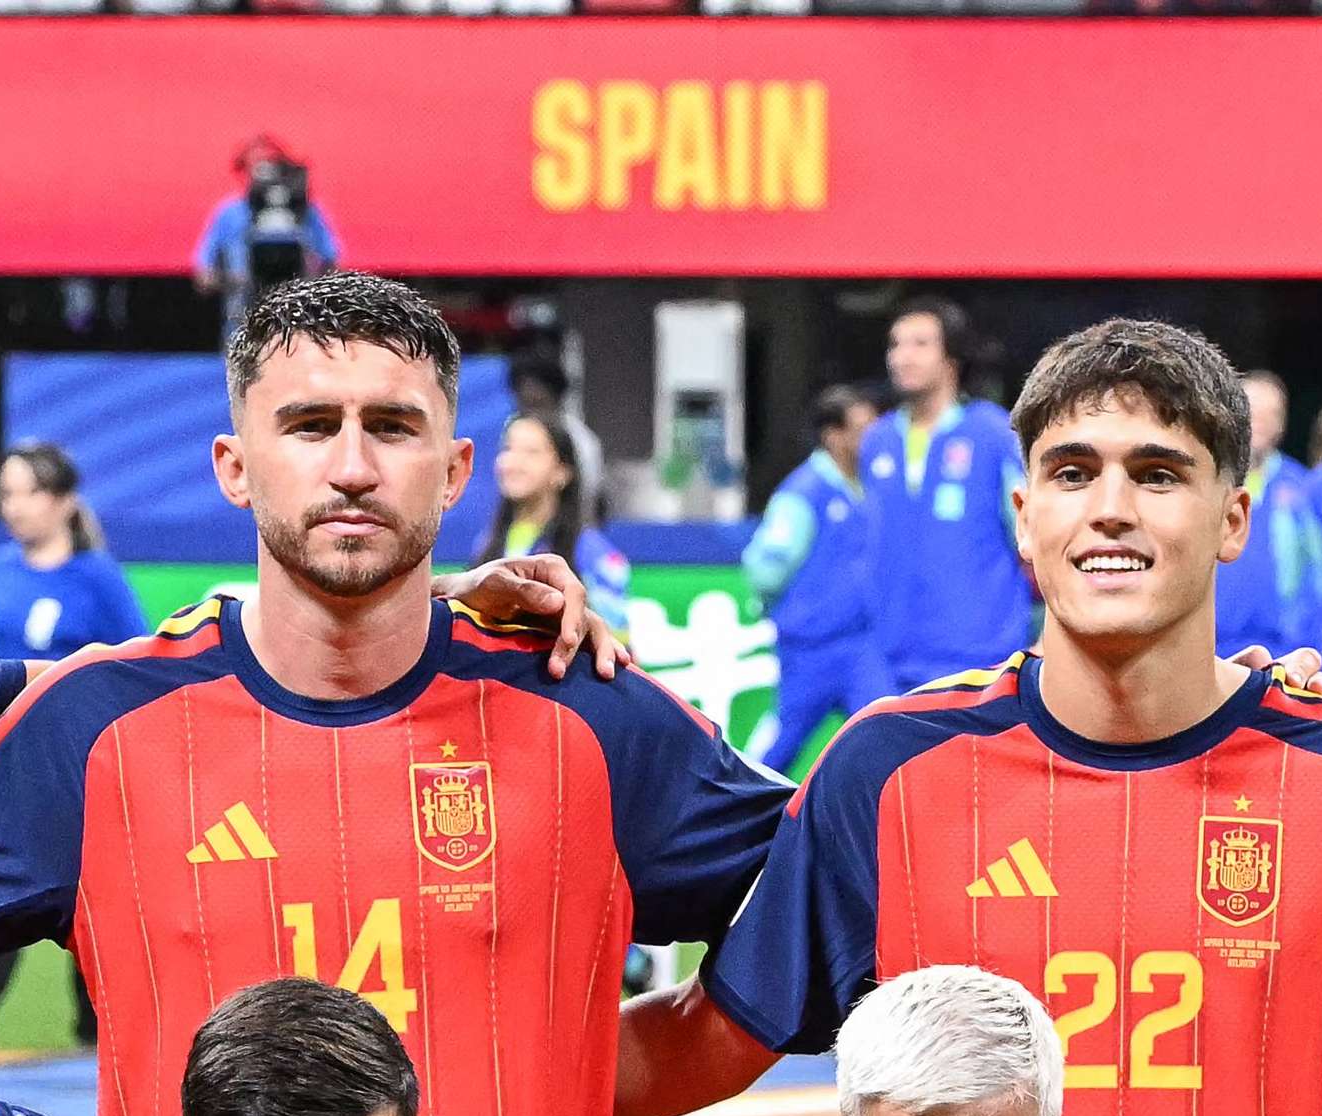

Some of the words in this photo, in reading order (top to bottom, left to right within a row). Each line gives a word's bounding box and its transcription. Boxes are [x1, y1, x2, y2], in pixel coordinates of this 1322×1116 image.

[532, 79, 827, 211] SPAIN
[282, 899, 417, 1032] 14
[1044, 950, 1204, 1090] 22
